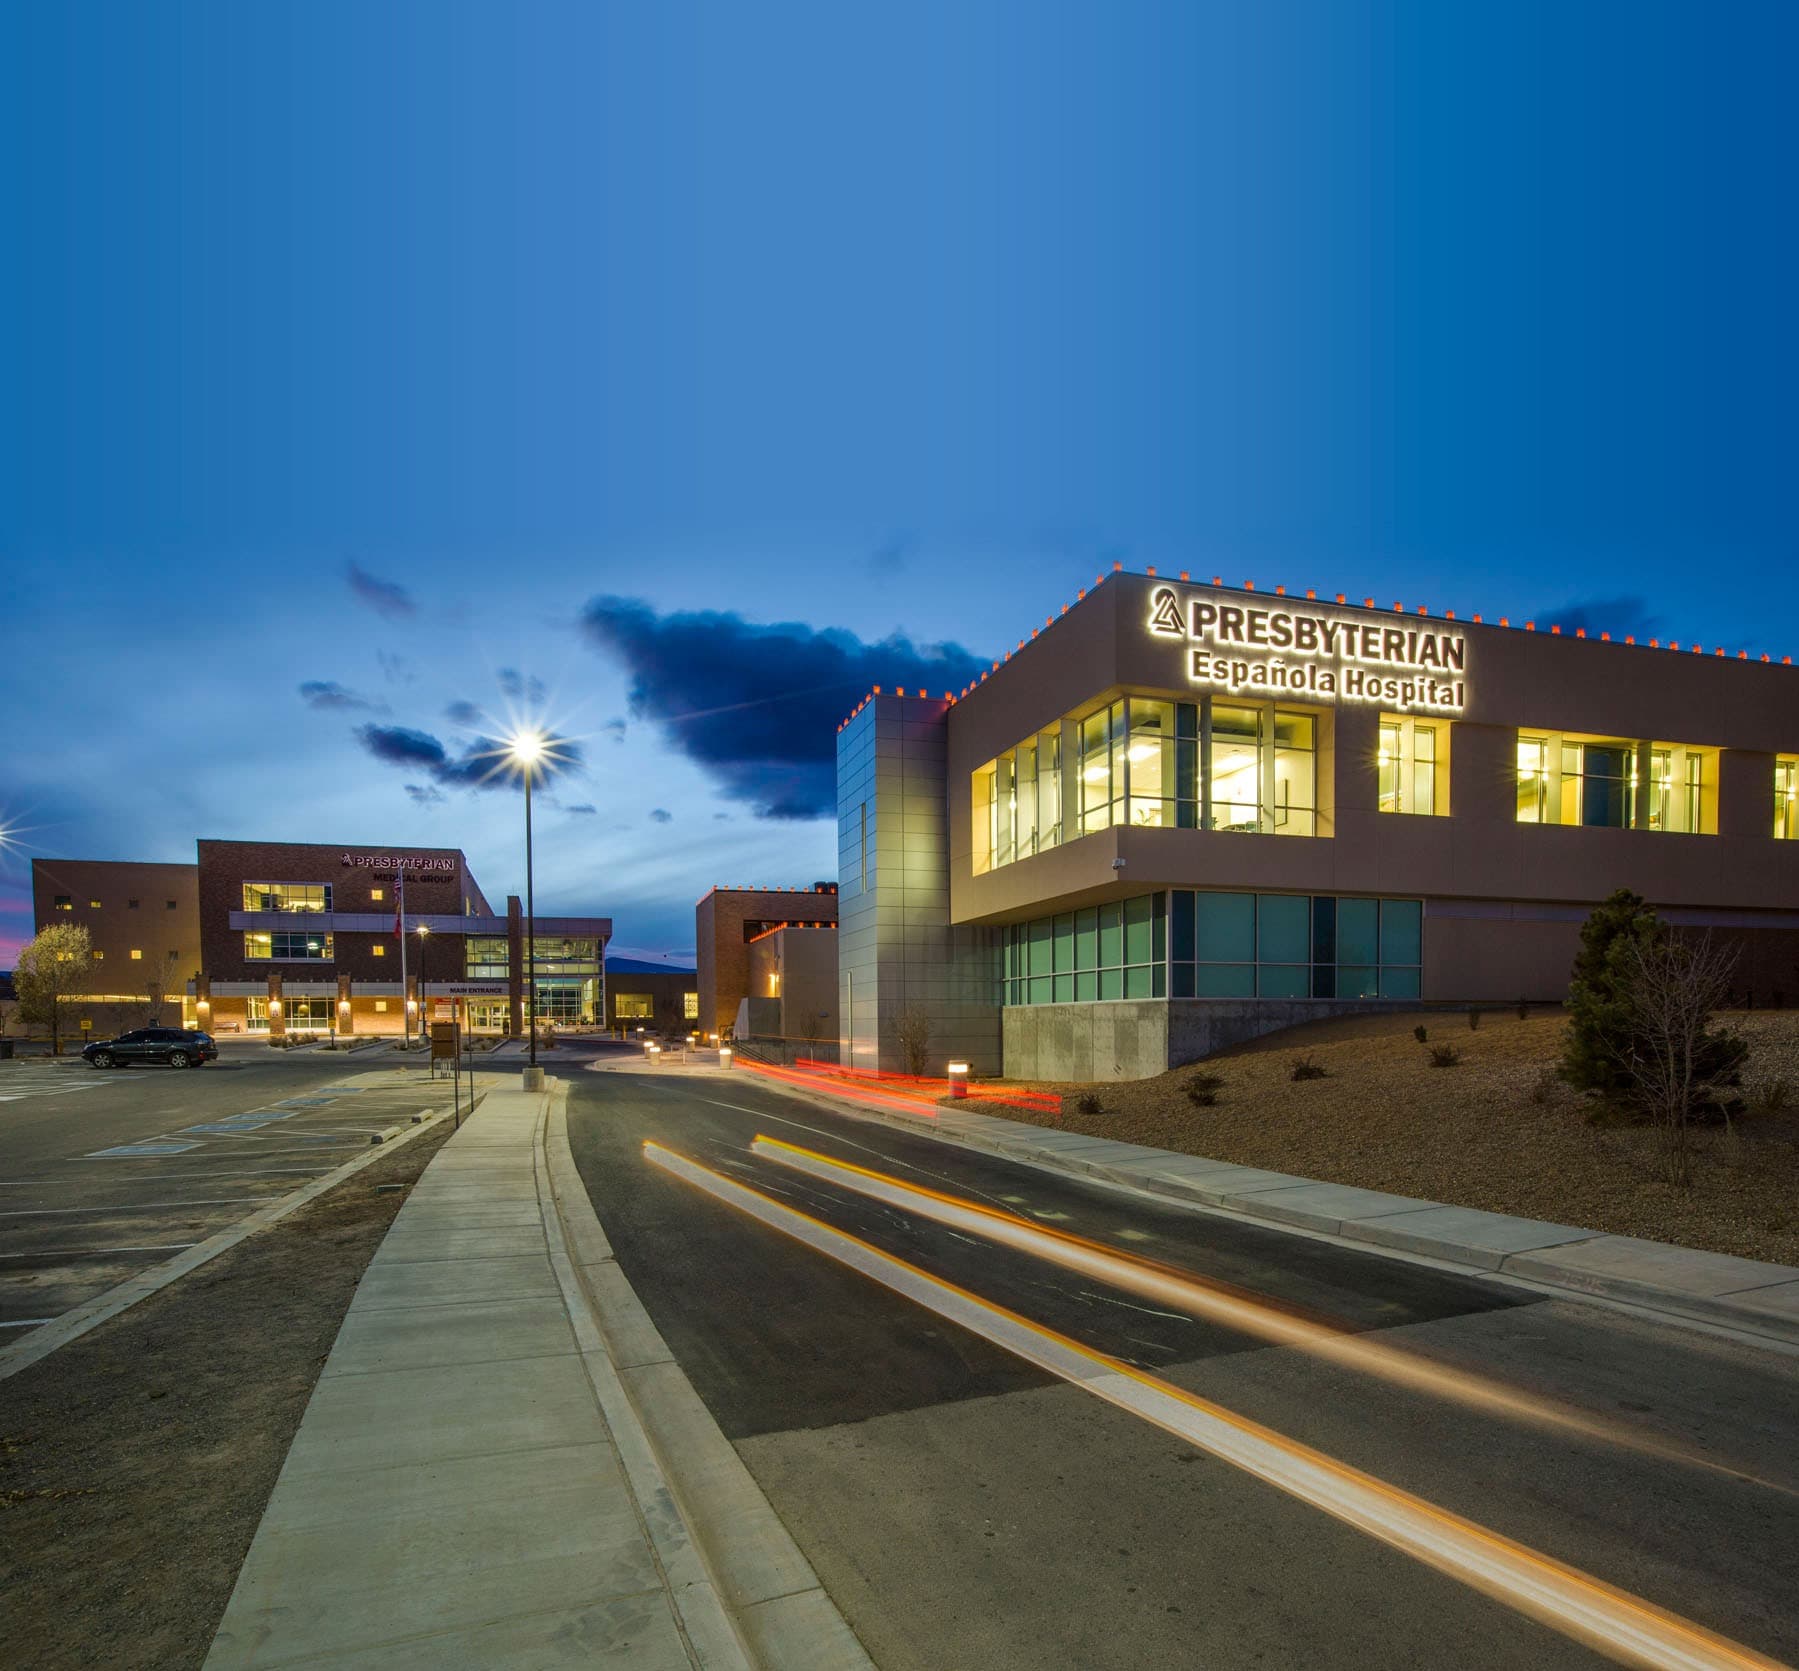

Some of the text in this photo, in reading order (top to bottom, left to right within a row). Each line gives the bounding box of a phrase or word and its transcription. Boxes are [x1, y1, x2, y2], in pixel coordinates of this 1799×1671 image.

[1191, 601, 1464, 671] PRESBYTERIAN
[1192, 650, 1464, 707] Española Hospital
[354, 857, 454, 870] PRESBYTERIAN
[420, 874, 454, 883] GROUP
